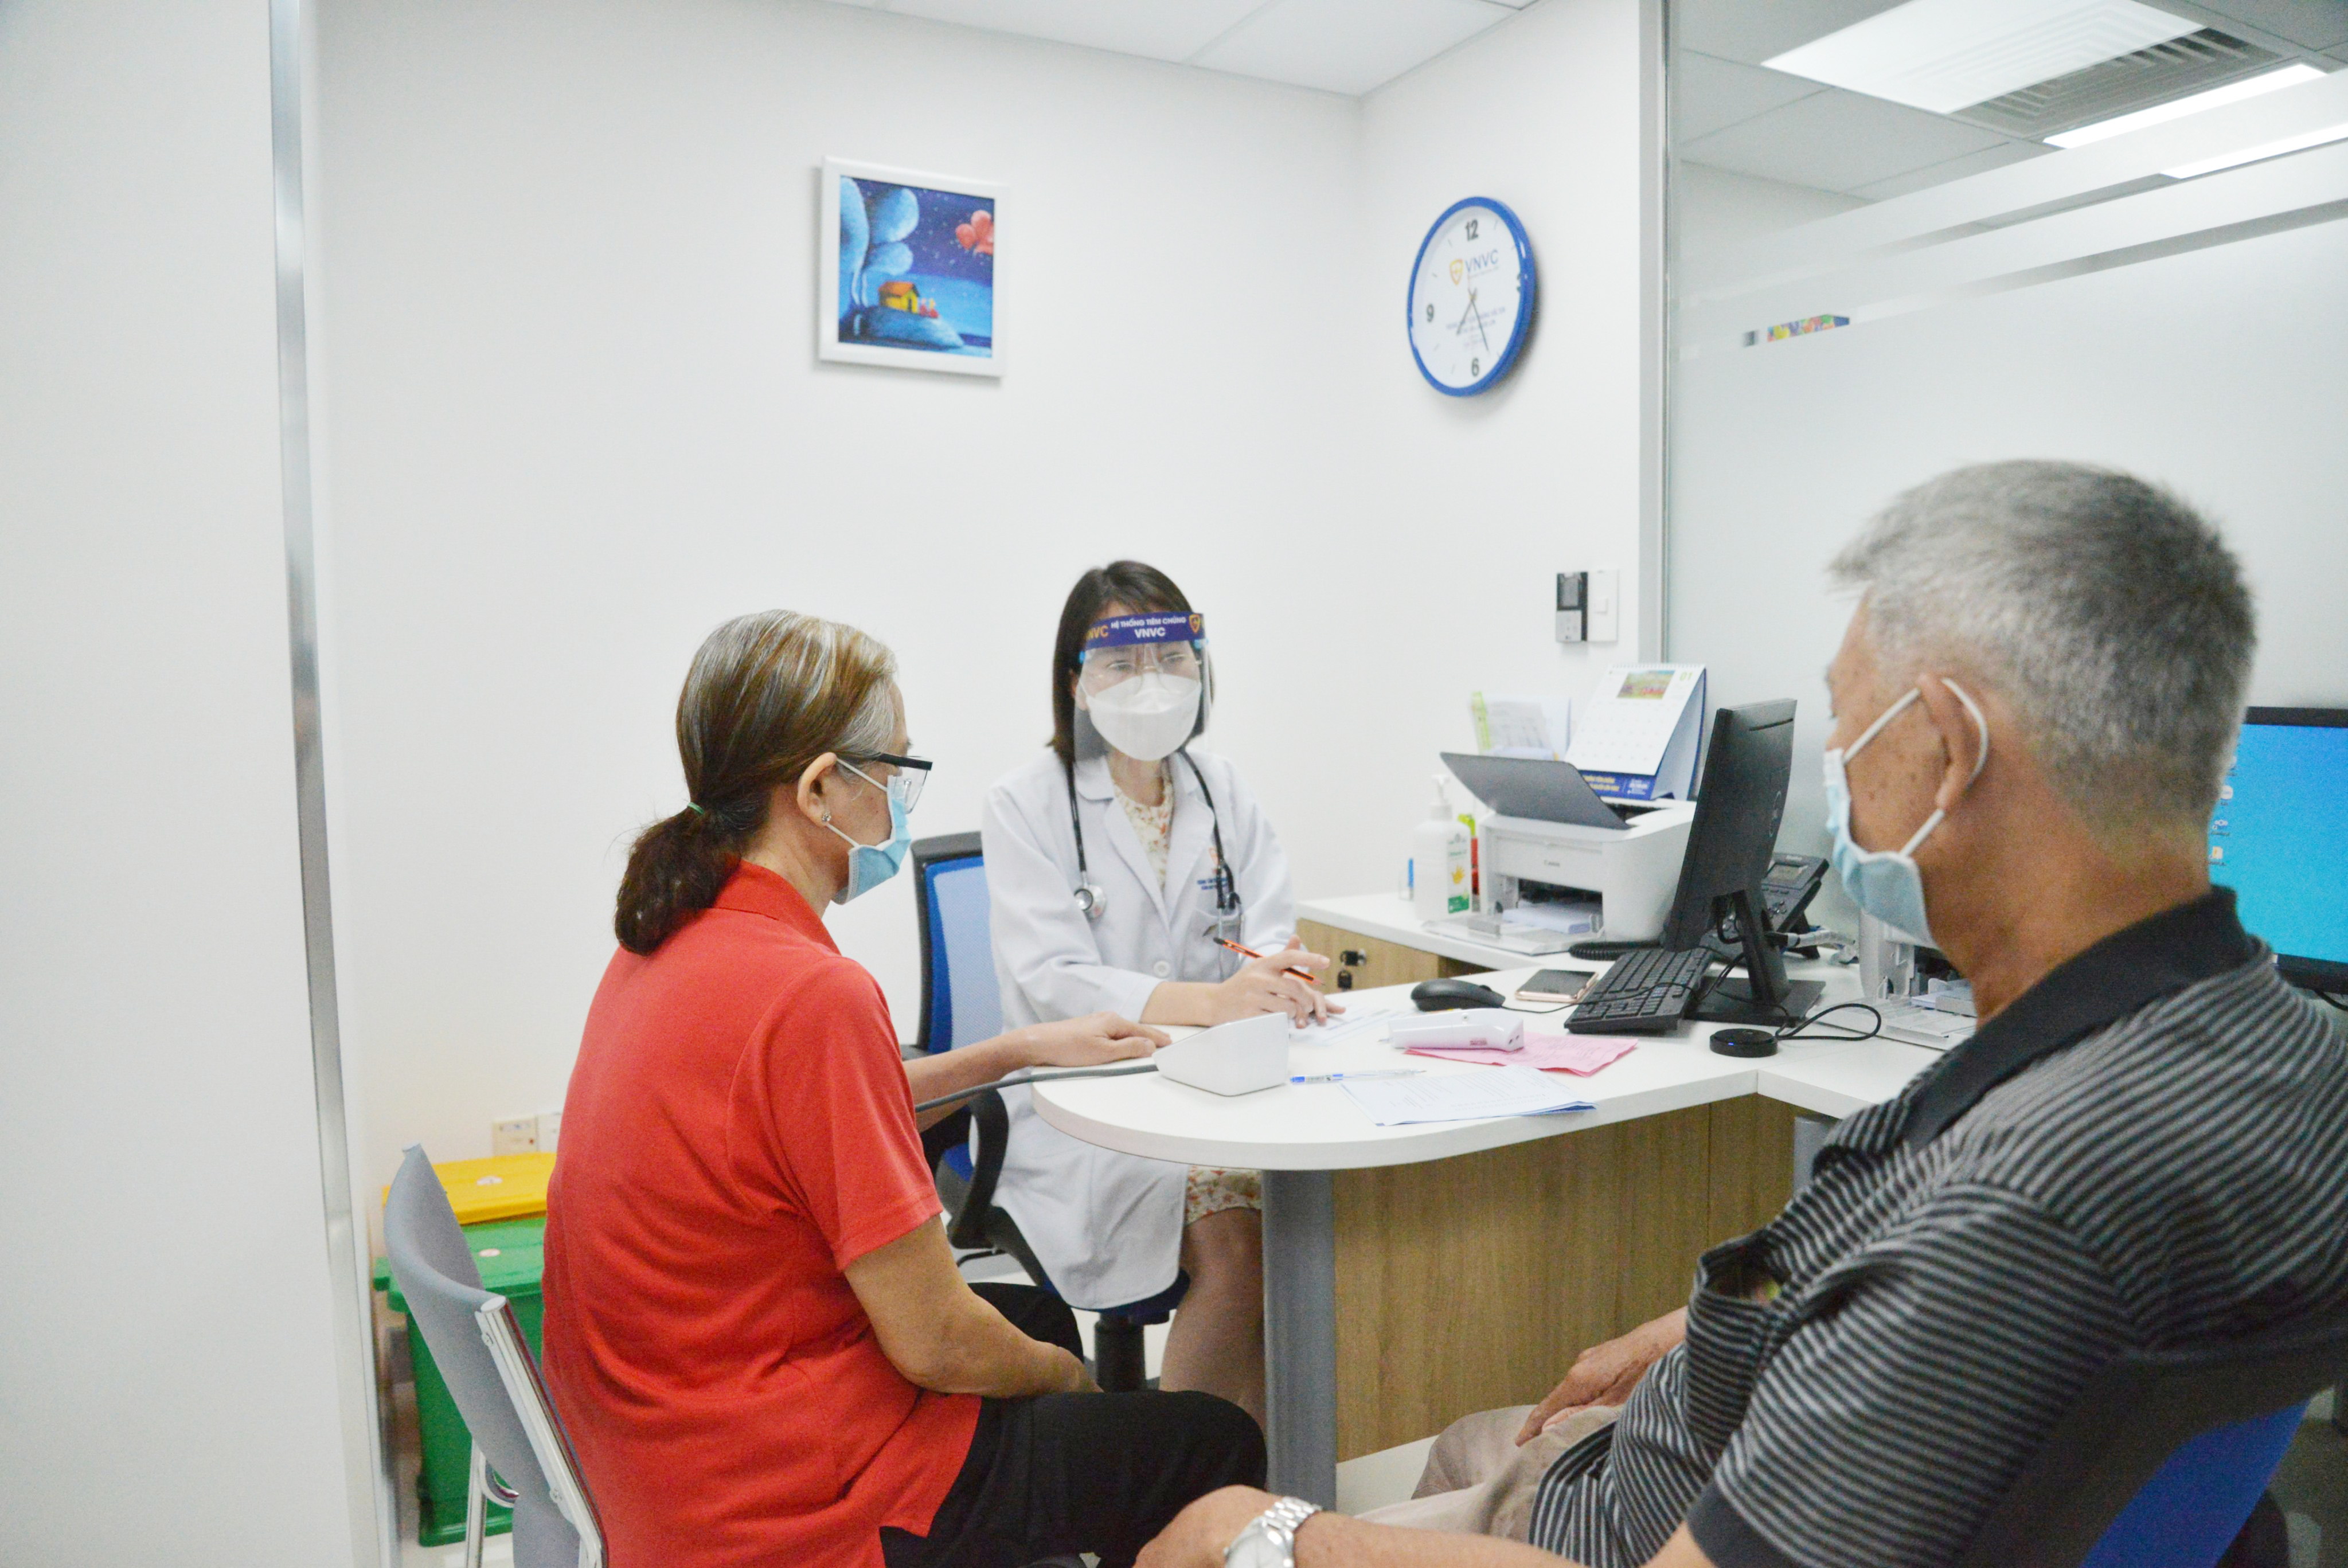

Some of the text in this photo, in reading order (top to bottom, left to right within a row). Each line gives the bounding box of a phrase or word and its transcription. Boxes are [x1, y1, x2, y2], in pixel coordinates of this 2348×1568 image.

[1465, 219, 1478, 241] 12
[1465, 248, 1498, 272] VNVC
[1427, 303, 1434, 323] 9
[1471, 357, 1479, 377] 6
[1111, 620, 1119, 629] HỆ
[1135, 627, 1166, 639] VNVC
